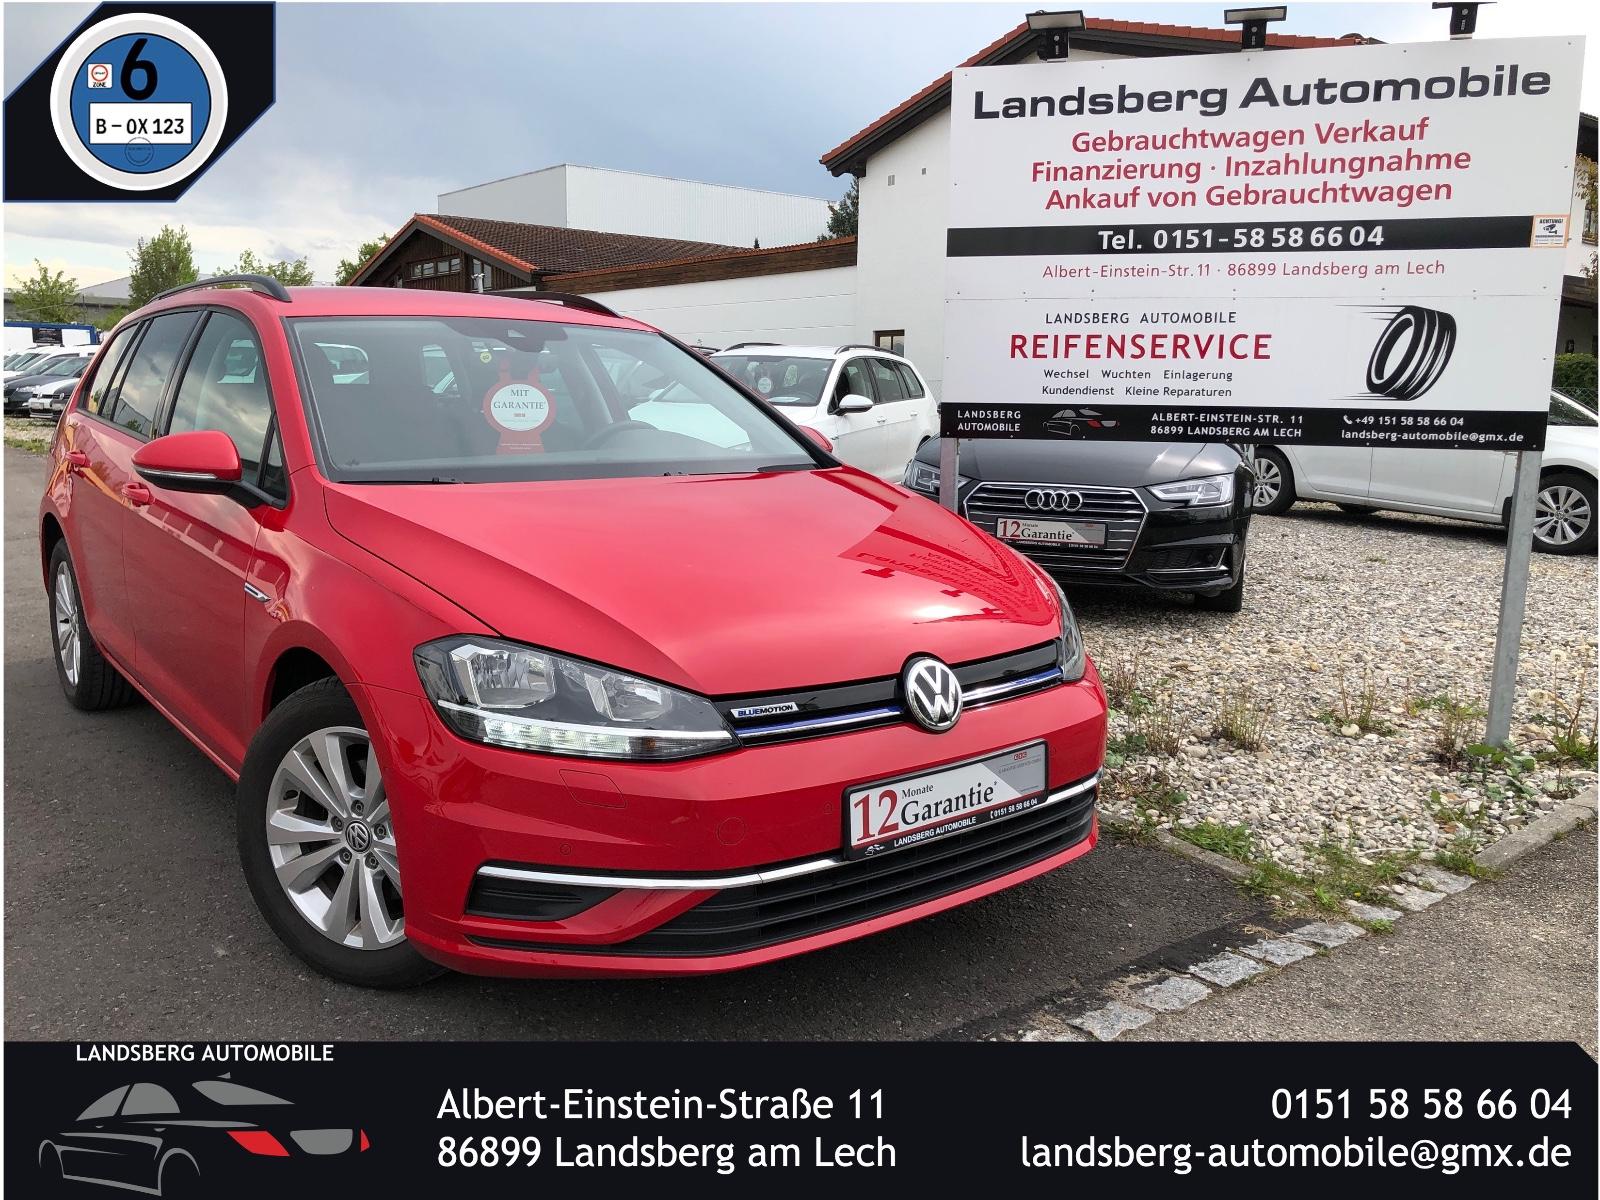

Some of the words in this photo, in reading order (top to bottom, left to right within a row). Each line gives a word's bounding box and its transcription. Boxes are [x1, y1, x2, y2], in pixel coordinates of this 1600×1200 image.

[974, 85, 1227, 120] Landsberg
[1239, 64, 1552, 109] Automobile
[1072, 128, 1305, 155] Gebrauchtwagen
[1316, 121, 1429, 145] Verkauf
[1032, 157, 1201, 185] Finanzierung
[1225, 149, 1471, 178] Inzahlungnahme
[1045, 185, 1140, 211] Ankauf
[1148, 189, 1197, 208] von
[1206, 179, 1452, 207] Gebrauchtwagen
[1098, 230, 1142, 250] Tel.
[1272, 228, 1303, 248] 58
[1310, 226, 1343, 247] 66
[1350, 226, 1384, 246] 04
[1227, 263, 1277, 276] 86899
[1282, 262, 1369, 278] Landsberg
[1375, 263, 1399, 275] am
[1406, 260, 1445, 275] Lech
[1045, 312, 1130, 324] LANDSBERG
[1140, 311, 1237, 324] AUTOMOBILE
[1010, 333, 1273, 360] REIFENSERVICE
[1044, 369, 1089, 379] Wechsel
[1101, 369, 1151, 379] Wuchten
[1163, 369, 1233, 382] Einlagerung
[1042, 385, 1115, 395] Kundendienst
[1125, 386, 1159, 396] Kleine
[1163, 386, 1232, 398] Reparaturen
[957, 410, 1021, 419] LANDSBERG
[1152, 413, 1283, 424] ALBERT-EINSTEIN-STR.
[1291, 415, 1303, 424] 11
[1355, 416, 1374, 425] +49
[1378, 416, 1397, 425] 151
[1400, 416, 1413, 425] 58
[1417, 416, 1430, 425] 58
[1433, 416, 1447, 426] 66
[1450, 417, 1464, 426] 04
[957, 422, 1020, 431] AUTOMOBILE
[1151, 426, 1184, 435] 86899
[1187, 427, 1250, 436] LANDSBERG
[1254, 428, 1270, 436] AM
[1273, 428, 1302, 437] LECH
[1341, 429, 1524, 443] landsberg-automobile@gmx.de
[1000, 520, 1020, 537] 12
[737, 704, 794, 717] BLUEMOTION
[902, 783, 934, 799] Monate
[854, 789, 899, 842] 12
[994, 807, 1006, 817] 0151
[1009, 805, 1015, 813] 58
[1031, 798, 1037, 806] 04
[894, 829, 934, 847] LANDSBERG
[935, 817, 976, 835] AUTOMOBILE
